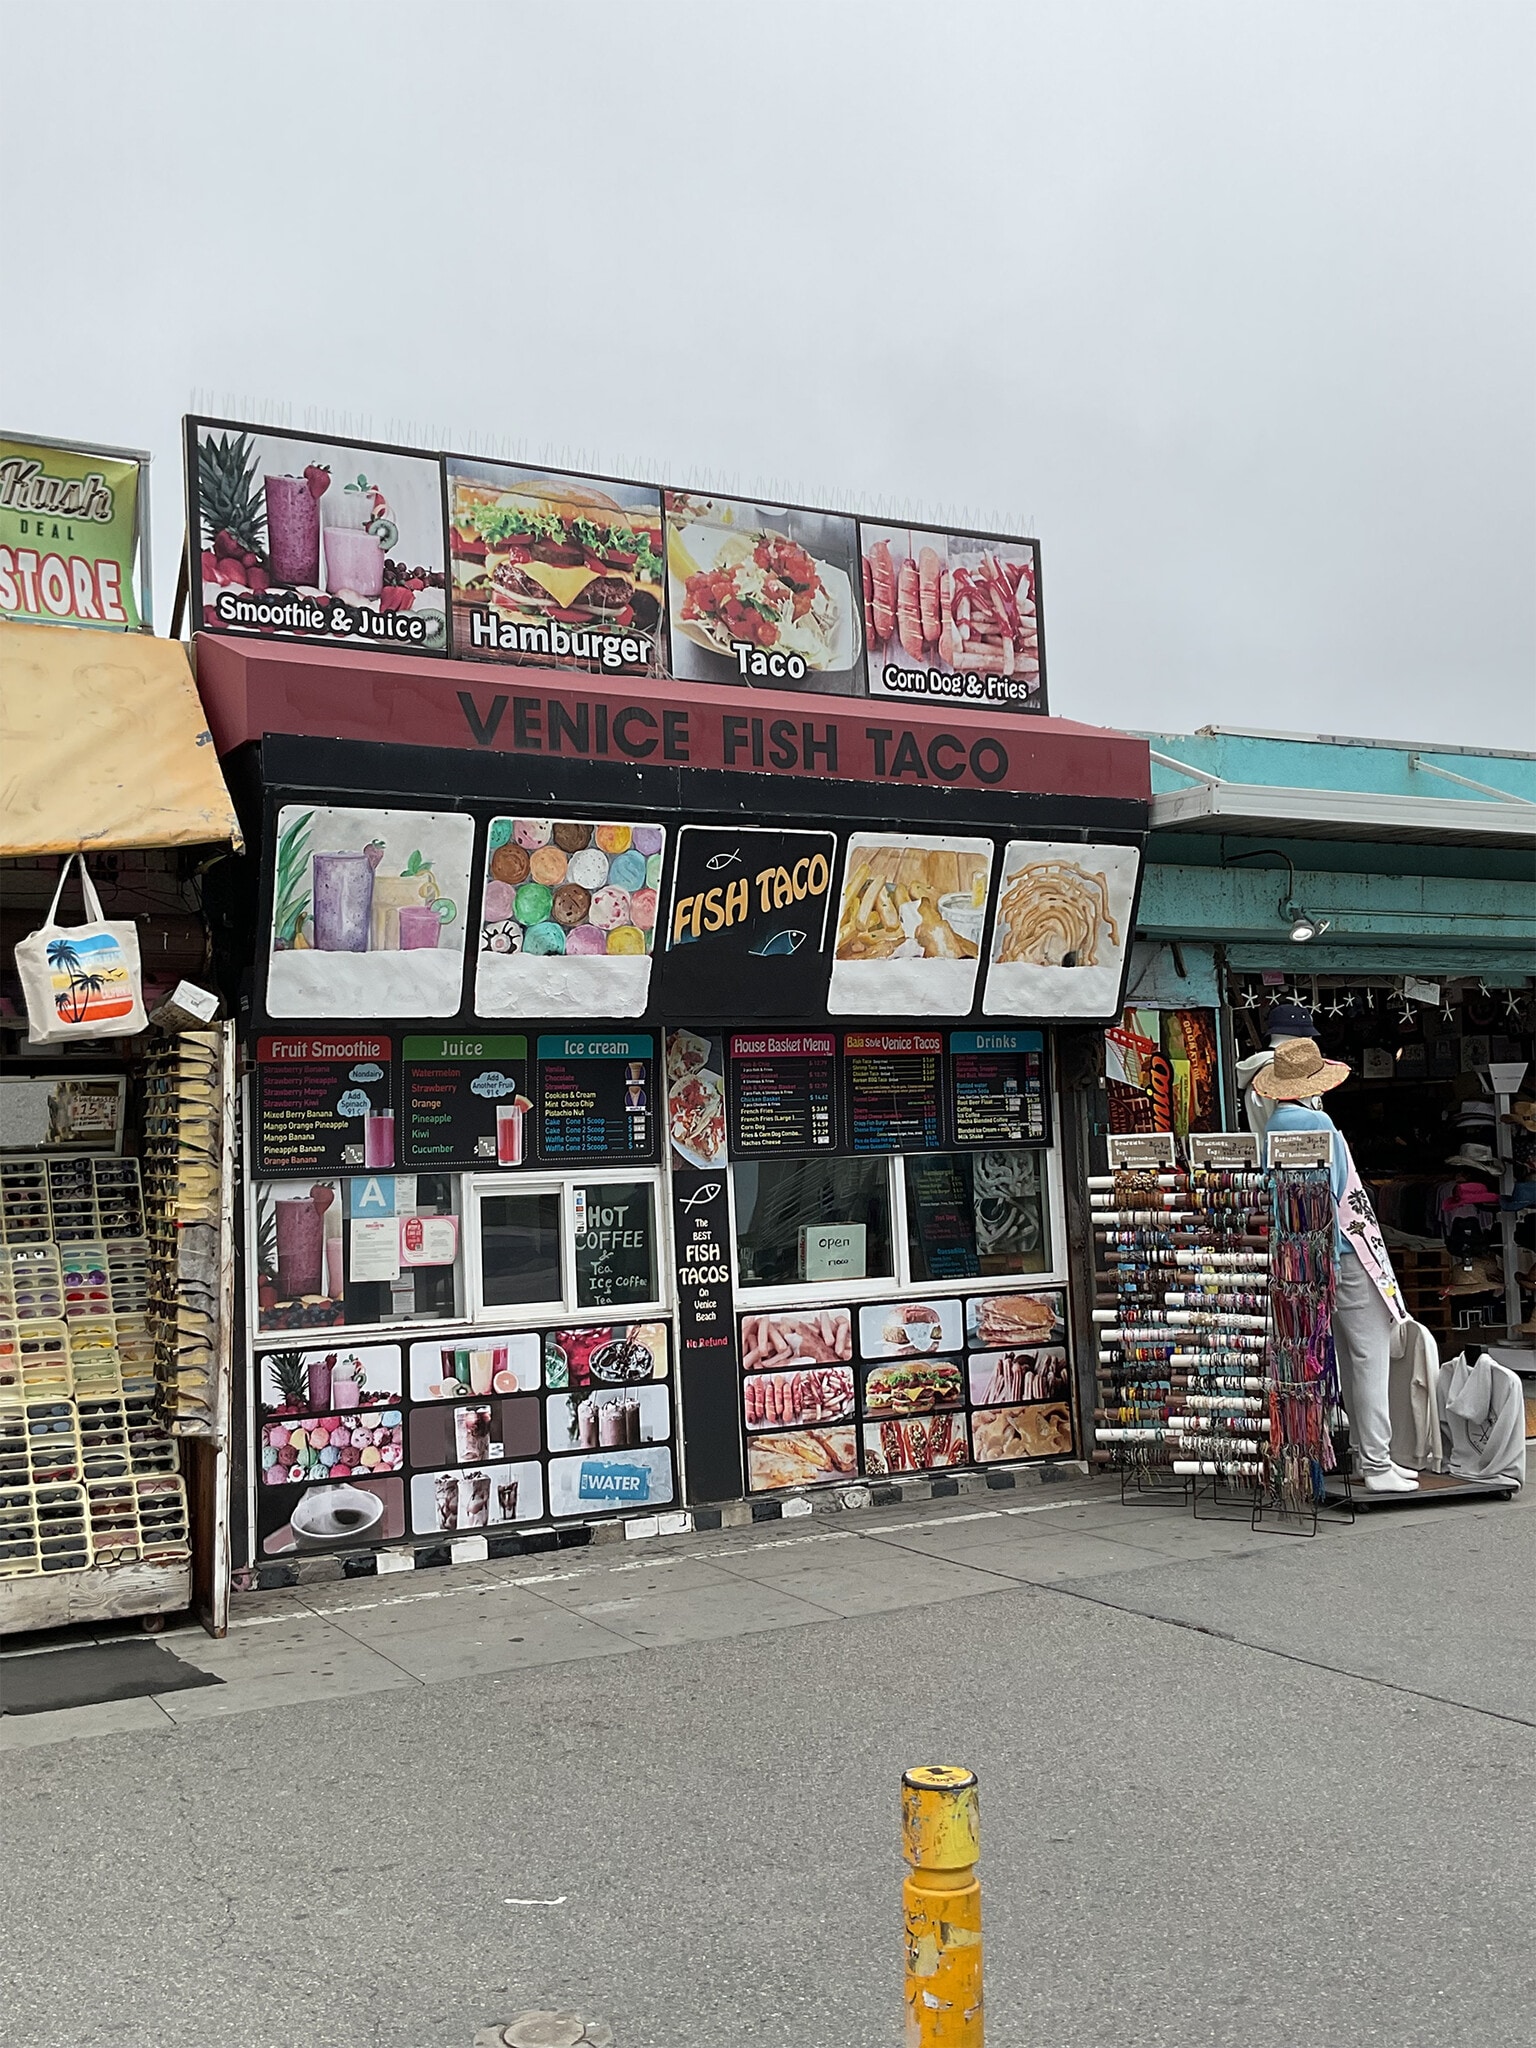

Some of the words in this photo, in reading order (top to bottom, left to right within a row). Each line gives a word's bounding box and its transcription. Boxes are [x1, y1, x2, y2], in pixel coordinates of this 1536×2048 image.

[0, 458, 113, 523] Kush
[20, 519, 74, 540] DEAL
[0, 546, 127, 621] STORE
[220, 596, 325, 629] Smoothie
[330, 608, 353, 631] &
[359, 611, 423, 638] Juice
[473, 614, 651, 667] Hamburger
[732, 643, 805, 679] Taco
[885, 667, 925, 690] Corn
[930, 672, 962, 694] Dog
[967, 676, 982, 695] &
[988, 677, 1027, 699] Fries
[457, 691, 690, 762] VENICE
[722, 716, 837, 773] FISH
[865, 728, 1009, 784] TACO
[673, 878, 749, 945] FISH
[756, 854, 829, 913] TACO
[565, 1040, 584, 1055] Ice
[589, 1042, 629, 1054] cream
[735, 1039, 766, 1053] House
[768, 1038, 801, 1052] Basket
[803, 1038, 830, 1052] Menu
[847, 1036, 864, 1048] Baja
[882, 1036, 912, 1050] Venice
[913, 1036, 940, 1050] Tacos
[977, 1035, 1017, 1048] Drinks
[272, 1042, 307, 1058] Fruit
[312, 1041, 380, 1057] Smoothie
[441, 1041, 483, 1056] Juice
[1183, 1020, 1200, 1080] HOLLYWOOD
[353, 1071, 382, 1079] Nondairy
[412, 1069, 460, 1077] Watermelon
[412, 1084, 457, 1093] Strawberry
[412, 1099, 441, 1110] Orange
[580, 1100, 594, 1108] Chip
[286, 1111, 305, 1120] Berry
[307, 1110, 333, 1118] Banana
[412, 1114, 452, 1125] Pineapple
[587, 1117, 605, 1125] Scoop
[264, 1123, 287, 1132] Mango
[289, 1122, 313, 1130] Orange
[315, 1121, 349, 1130] Pineapple
[587, 1126, 605, 1134] Scoop
[264, 1134, 287, 1143] Mango
[289, 1133, 314, 1141] Banana
[412, 1129, 430, 1138] Kiwi
[587, 1135, 605, 1143] Scoop
[264, 1146, 299, 1154] Pineapple
[412, 1145, 454, 1154] Cucumber
[545, 1144, 564, 1152] Waffle
[587, 1143, 608, 1151] Scoops
[264, 1157, 289, 1165] Orange
[359, 1178, 386, 1207] A
[588, 1206, 629, 1228] HOT
[695, 1219, 709, 1228] The
[576, 1230, 644, 1251] COFFEE
[693, 1231, 712, 1241] BEST
[686, 1244, 720, 1263] FISH
[590, 1261, 613, 1275] Tea
[679, 1265, 729, 1286] TACOS
[589, 1278, 612, 1290] Ice
[699, 1288, 709, 1297] On
[594, 1296, 613, 1305] Tea
[694, 1300, 717, 1310] Venice
[696, 1311, 716, 1322] Beach
[699, 1336, 728, 1348] Refund
[588, 1475, 641, 1491] WATER
